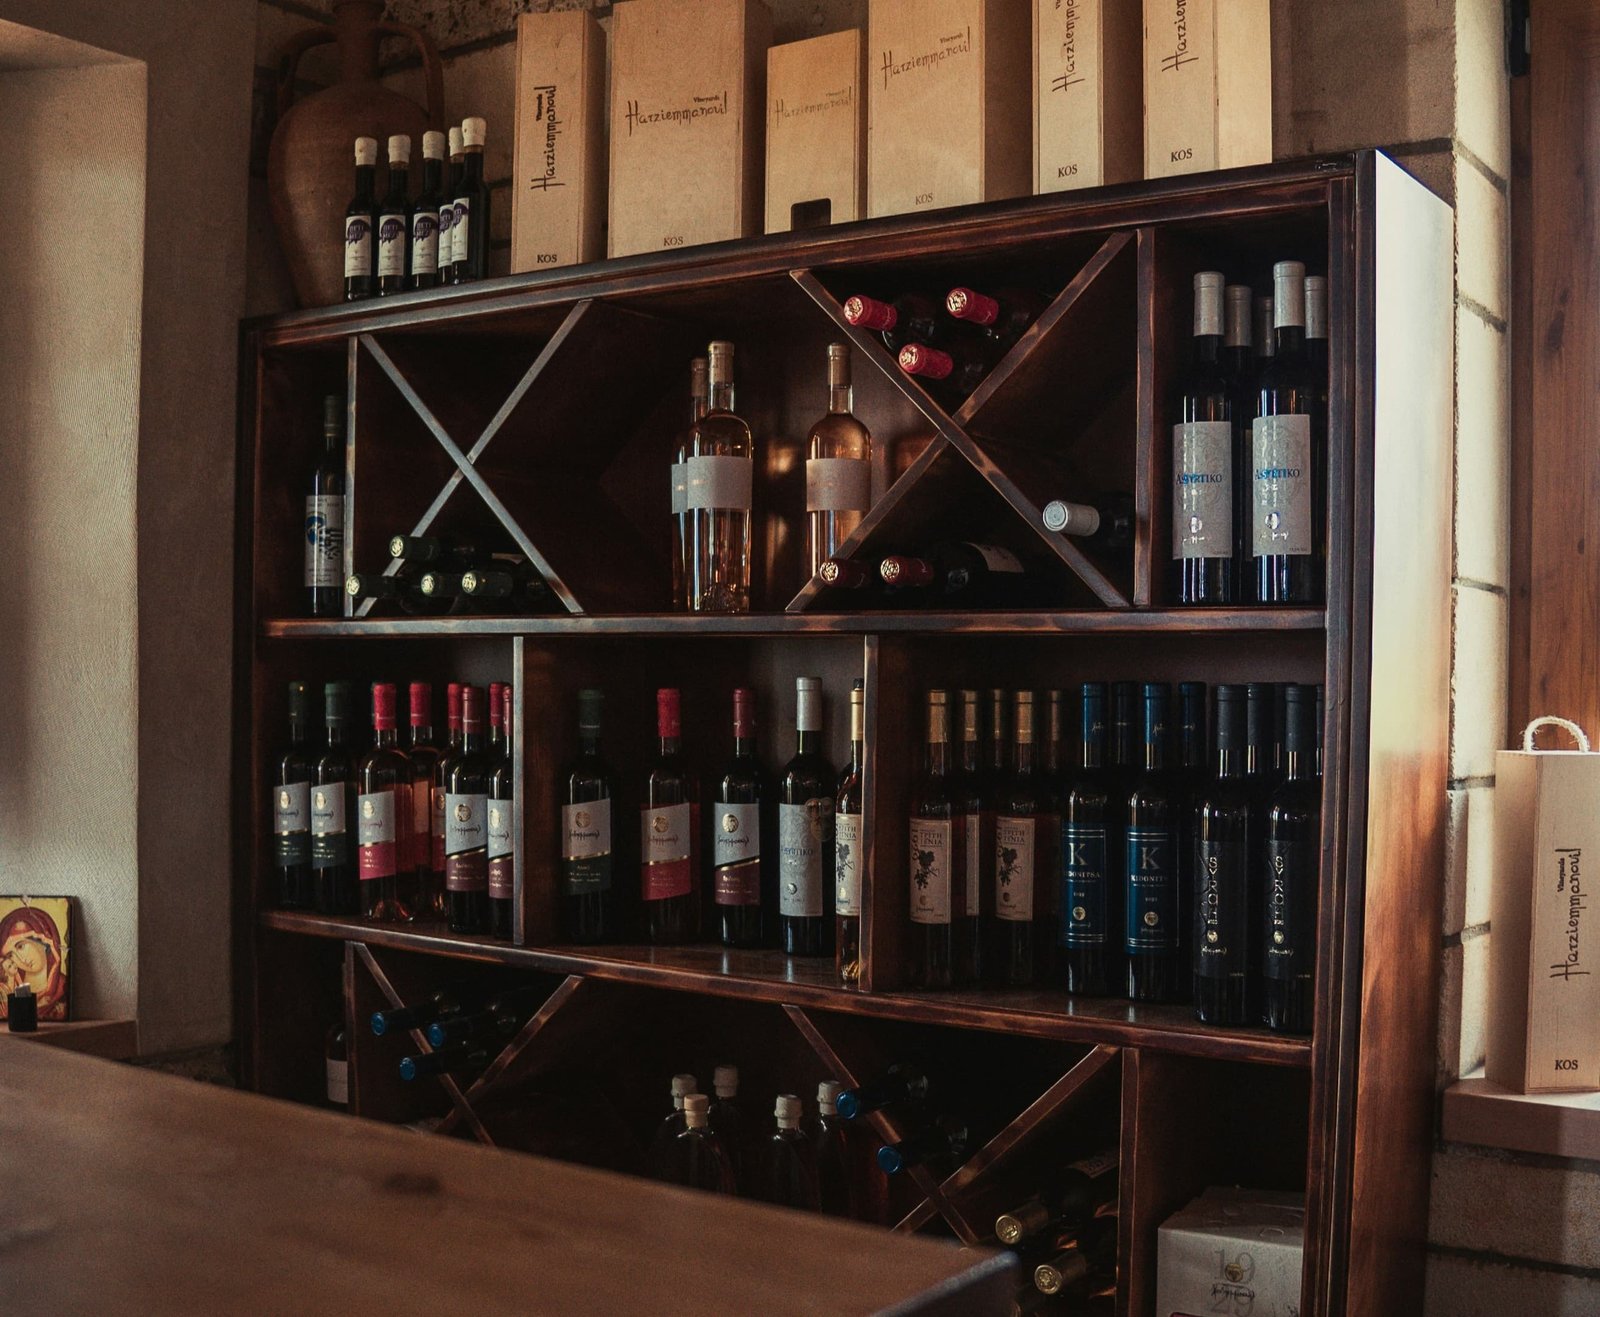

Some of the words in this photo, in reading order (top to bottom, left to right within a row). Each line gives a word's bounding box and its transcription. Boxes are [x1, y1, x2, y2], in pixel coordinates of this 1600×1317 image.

[1170, 148, 1193, 163] KOS
[1057, 163, 1078, 178] KOS
[915, 192, 934, 206] KOS
[663, 236, 684, 247] KOS
[537, 253, 558, 264] KOS
[1069, 842, 1088, 866] K
[1141, 846, 1161, 870] K
[1554, 1058, 1579, 1071] KOS
